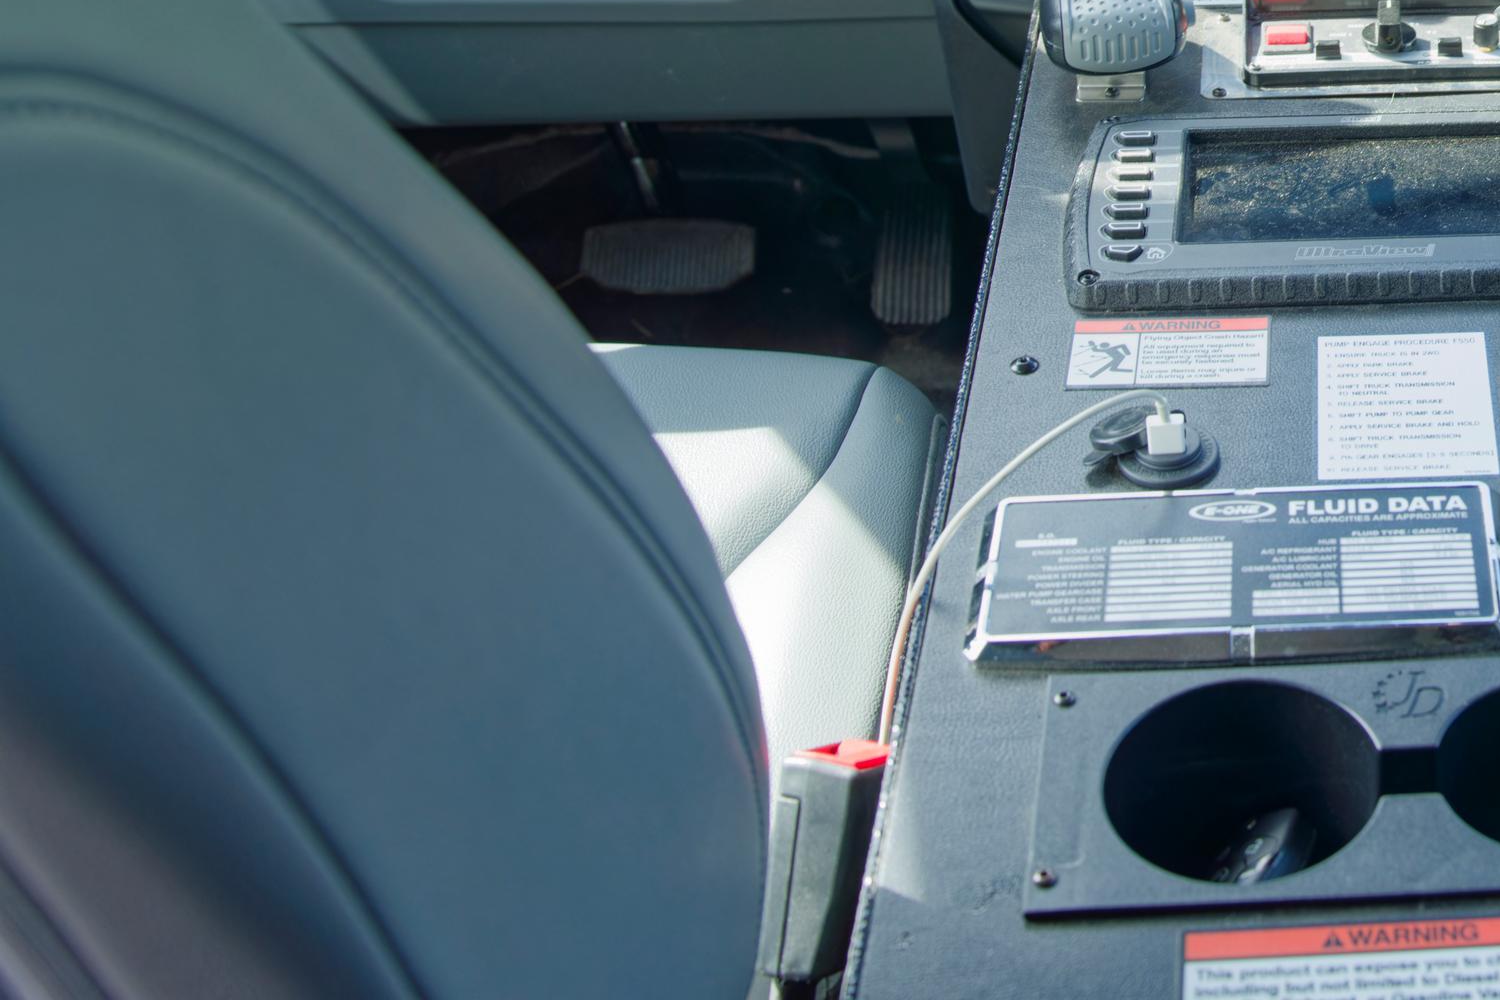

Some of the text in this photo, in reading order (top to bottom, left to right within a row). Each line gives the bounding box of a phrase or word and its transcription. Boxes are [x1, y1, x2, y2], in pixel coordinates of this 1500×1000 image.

[1139, 320, 1222, 331] WARNING
[1353, 339, 1391, 347] ENGAGE
[1393, 337, 1450, 346] PROCEDURE
[1203, 504, 1262, 517] E-ONE
[1287, 495, 1468, 516] FLUID DATA
[1288, 517, 1308, 525] ALL
[1309, 515, 1371, 524] CAPACITIES
[1371, 513, 1395, 522] ARE
[1395, 511, 1468, 521] APPROXIMATE
[1351, 526, 1459, 537] FLUID TYPE CAPACITY
[1117, 535, 1226, 546] FLUID TYPE CAPACITY
[1031, 546, 1107, 557] ENGINE COOLANT
[1274, 546, 1337, 555] REFRIGERANT
[1091, 555, 1106, 563] OIL
[1284, 554, 1337, 563] LUBRICANT
[1040, 563, 1106, 572] TRANSMISSION
[1241, 562, 1338, 573] GENERATOR COOLANT
[1268, 571, 1338, 580] GENERATOR OIL
[1035, 579, 1105, 589] POWER DIVIDER
[1270, 580, 1301, 588] AERIAL
[1323, 579, 1338, 587] OIL
[1027, 590, 1053, 598] PUMP
[1053, 588, 1102, 597] GEARCASE
[1030, 596, 1103, 607] TRANSFER CASE
[1046, 605, 1103, 615] AXLE FRONT
[1050, 614, 1102, 624] AXLE REAR
[1347, 922, 1481, 949] WARNING
[1196, 967, 1234, 980] This
[1239, 964, 1311, 982] product
[1315, 964, 1349, 974] can
[1354, 961, 1419, 975] expose
[1426, 959, 1459, 972] you
[1463, 956, 1481, 967] to
[1195, 983, 1280, 998] including
[1285, 980, 1316, 992] but
[1320, 978, 1350, 990] not
[1355, 975, 1416, 988] limited
[1420, 974, 1440, 986] to
[1444, 970, 1500, 985] Diesel
